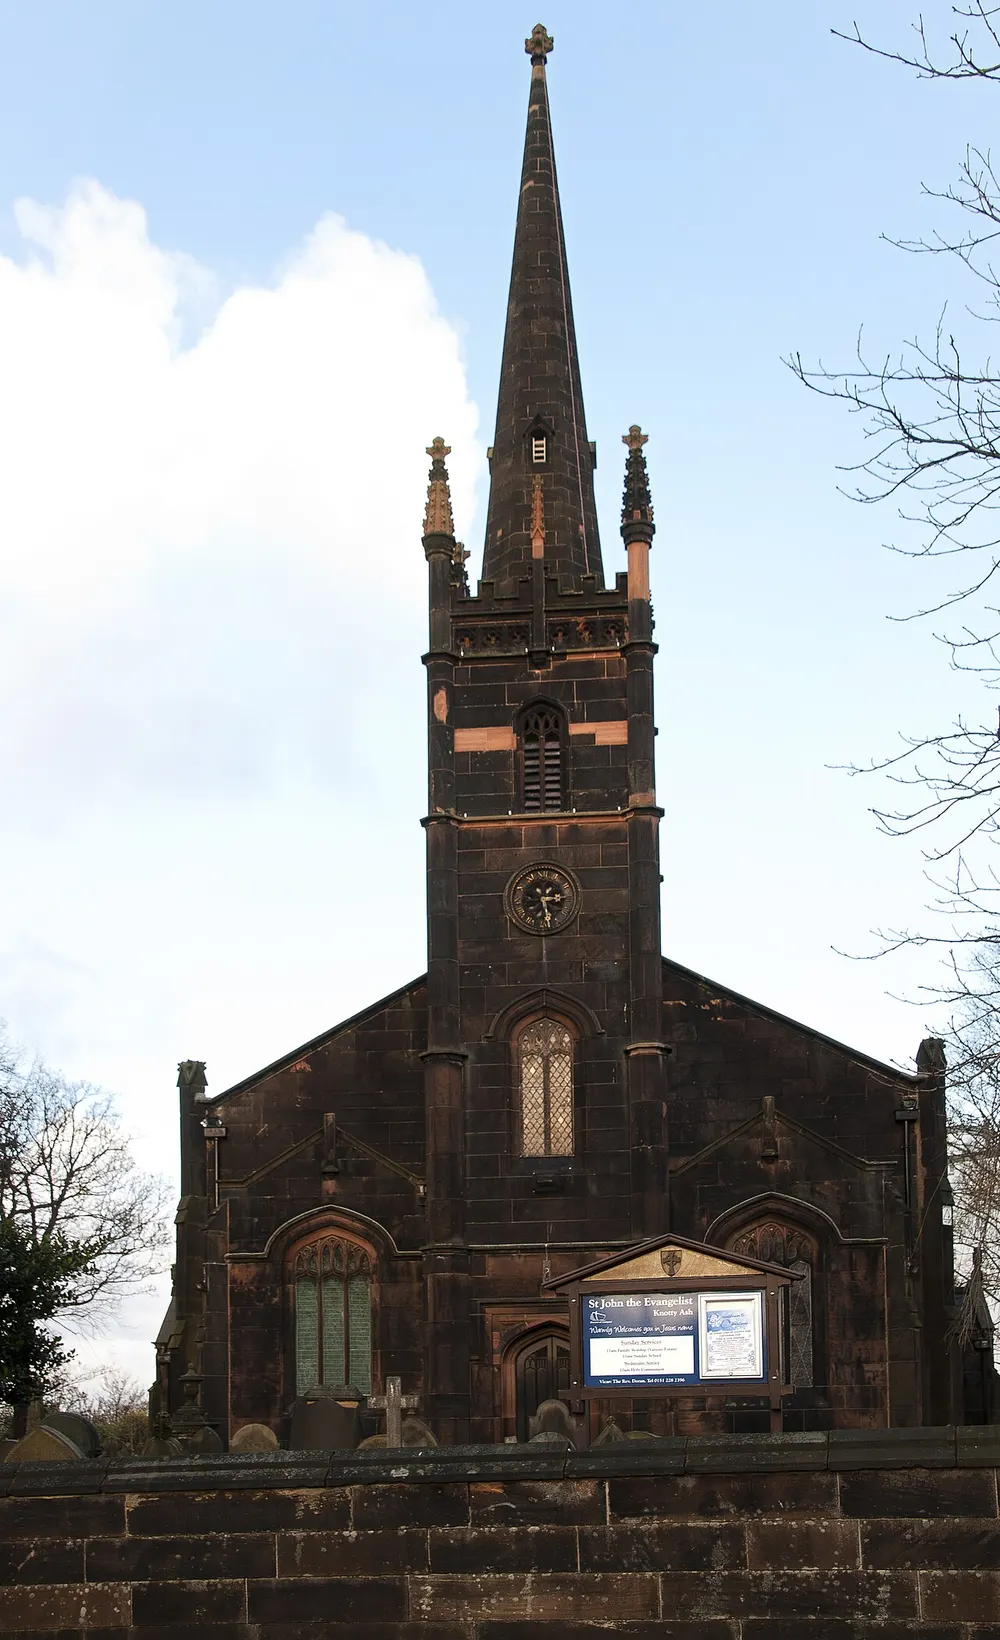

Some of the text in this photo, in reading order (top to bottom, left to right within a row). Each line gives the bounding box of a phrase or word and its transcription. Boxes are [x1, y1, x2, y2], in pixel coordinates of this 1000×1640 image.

[588, 1296, 693, 1309] St John the Evangelist
[588, 1326, 613, 1335] Warmly
[613, 1325, 642, 1334] Welcomes
[660, 1324, 677, 1334] Jesus
